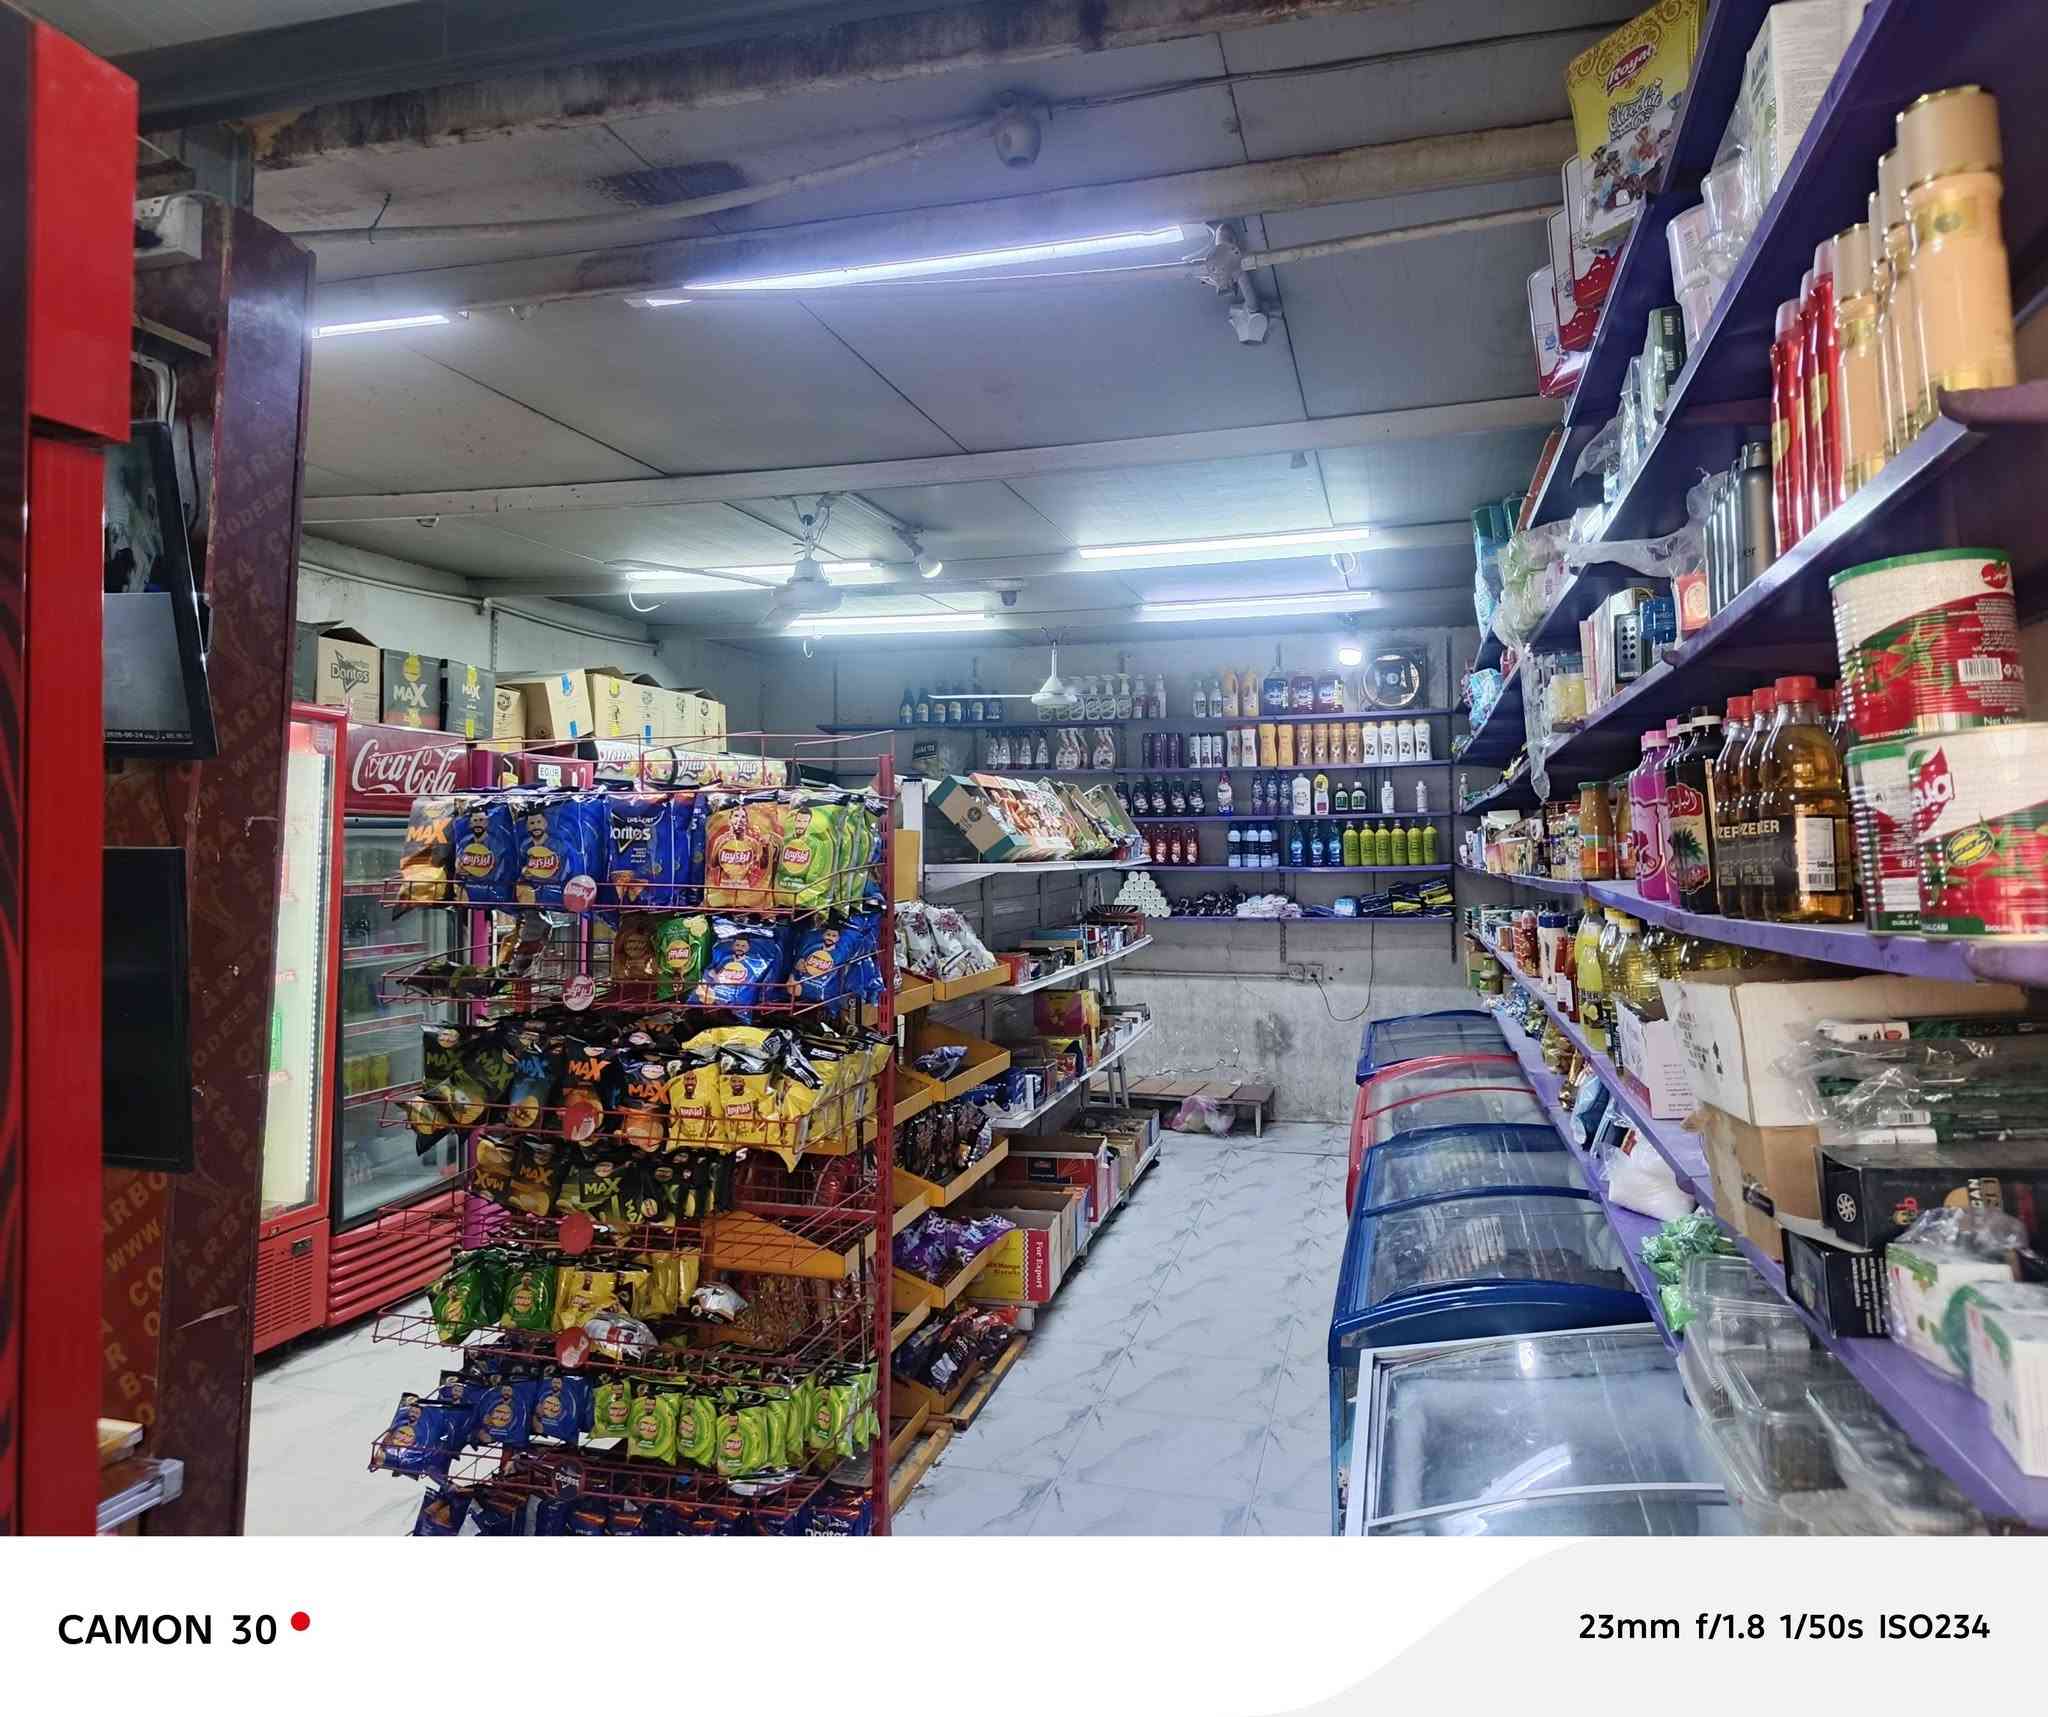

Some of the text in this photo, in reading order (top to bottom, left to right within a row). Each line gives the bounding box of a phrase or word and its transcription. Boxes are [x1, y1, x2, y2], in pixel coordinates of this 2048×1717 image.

[393, 682, 429, 708] MAX
[352, 739, 457, 794] Coca-Cola
[405, 816, 452, 844] MAX
[568, 1057, 611, 1081] MAX
[628, 1080, 673, 1104] MAX
[519, 1165, 553, 1185] MAX
[584, 1177, 622, 1196] MAX
[1034, 1259, 1044, 1288] Export
